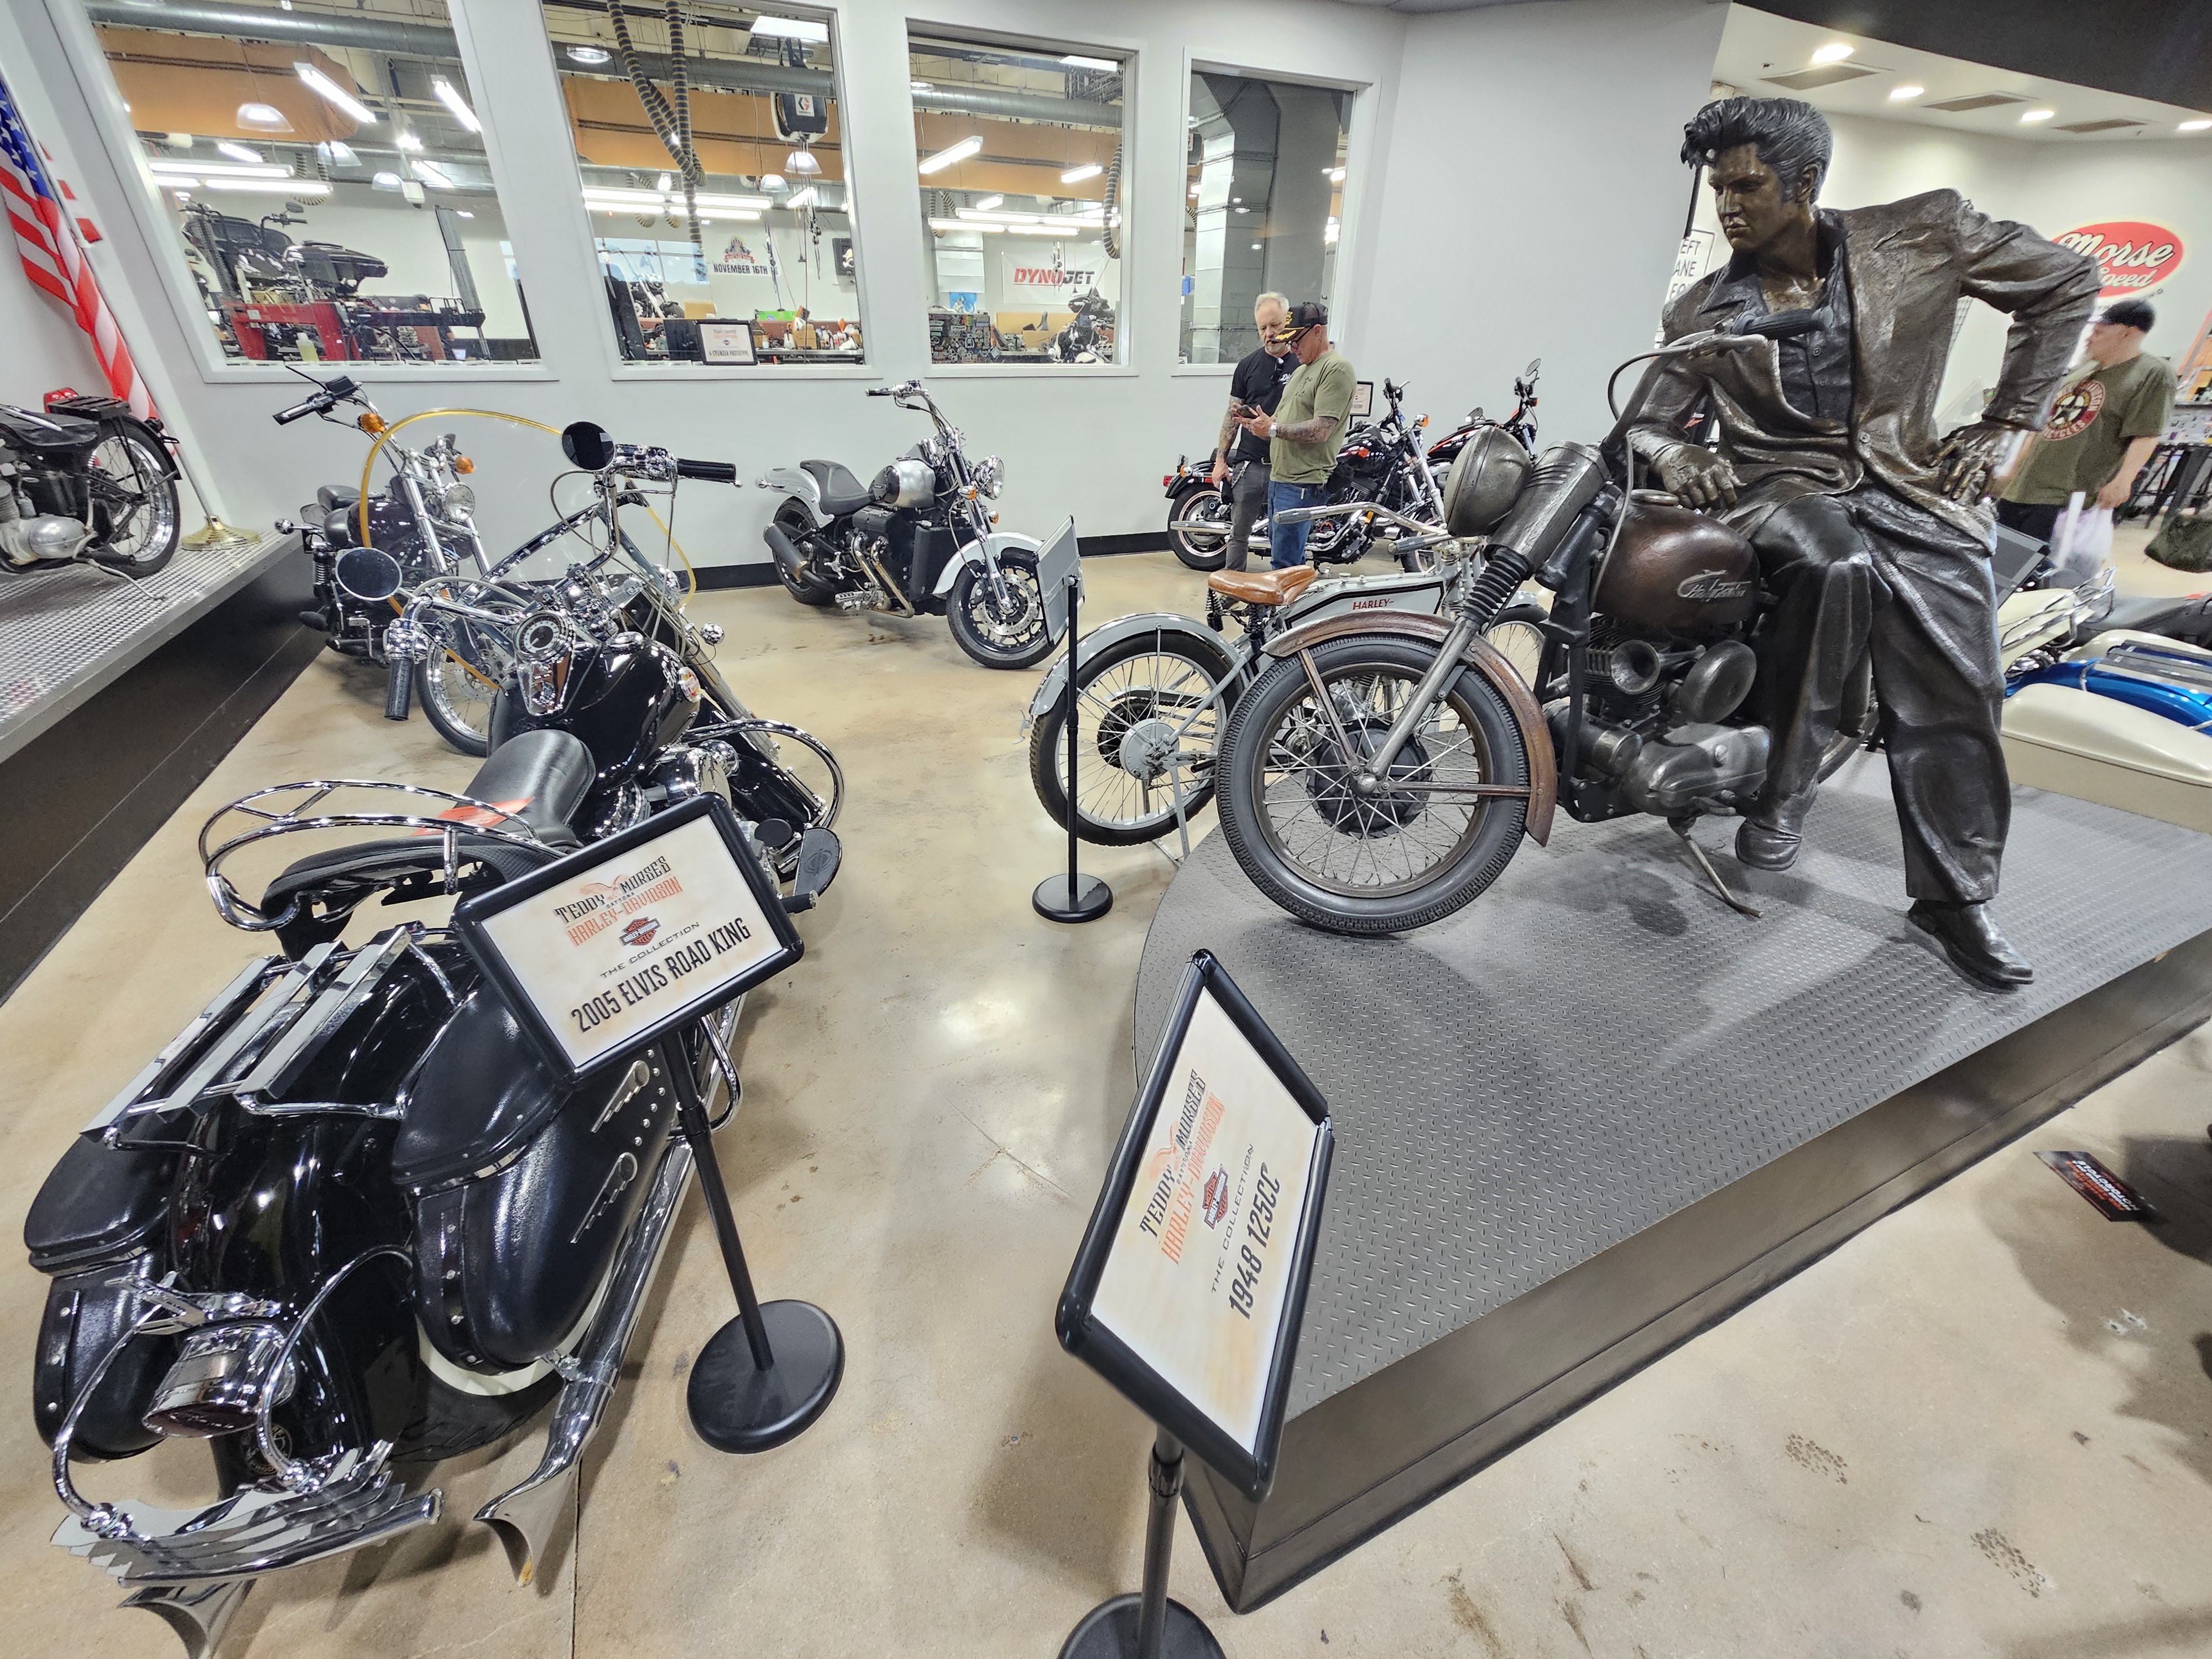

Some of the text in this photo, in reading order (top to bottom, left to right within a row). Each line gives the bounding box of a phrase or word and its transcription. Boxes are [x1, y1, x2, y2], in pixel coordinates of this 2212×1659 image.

[713, 264, 750, 274] NOVEMBER
[752, 265, 768, 275] 16TH
[1673, 260, 1697, 276] ANE
[1680, 239, 1701, 255] EFT
[2058, 232, 2175, 268] Morse
[1014, 268, 1095, 285] DYNOJET
[1669, 283, 1691, 300] FO
[1352, 598, 1394, 610] HARLEY-
[554, 855, 671, 924] TEDDY MORSE'S
[568, 876, 683, 946] HARLEY-DAVIDSON
[606, 891, 635, 908] DAYTONA
[600, 922, 699, 978] THE COLLECTION
[571, 917, 752, 1032] 2005 ELVIS ROAD KING
[1139, 1068, 1206, 1238] TEDDY MORSE'S
[1176, 1140, 1193, 1185] DAYTONA
[1161, 1092, 1225, 1265] HARLEY-DAVIDSON
[2078, 1160, 2140, 1211] MOTORCYCLE
[1212, 1144, 1254, 1293] THE COLLECTION
[1229, 1162, 1280, 1320] 1948 125CC
